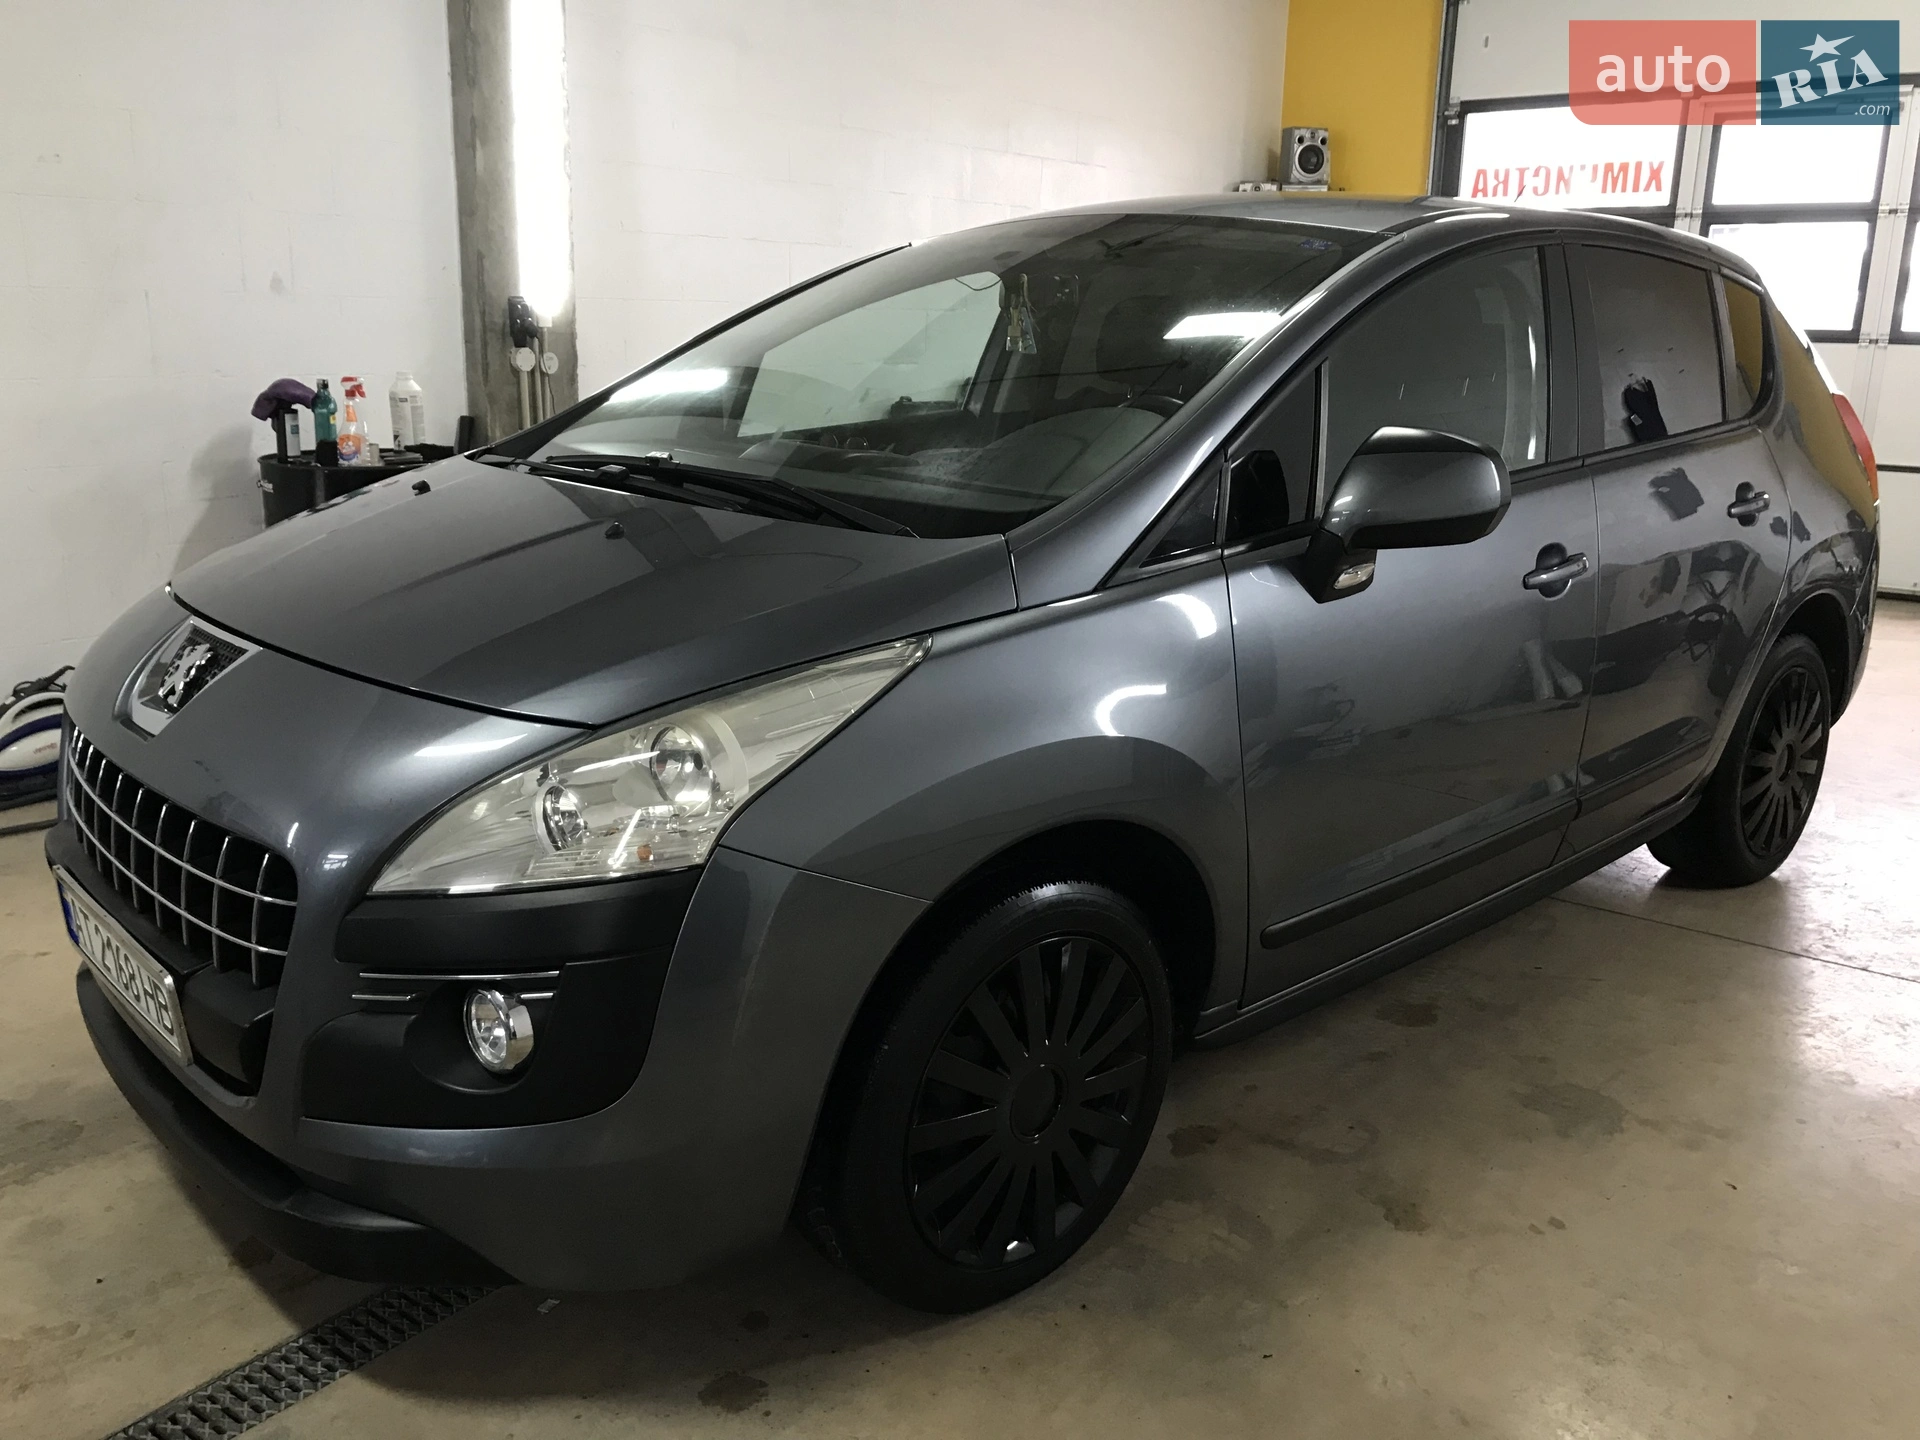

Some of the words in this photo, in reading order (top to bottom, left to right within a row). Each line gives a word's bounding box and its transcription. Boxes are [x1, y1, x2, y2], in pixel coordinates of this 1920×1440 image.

[70, 897, 95, 955] AT
[94, 924, 141, 1003] 2168
[137, 965, 174, 1036] HB
